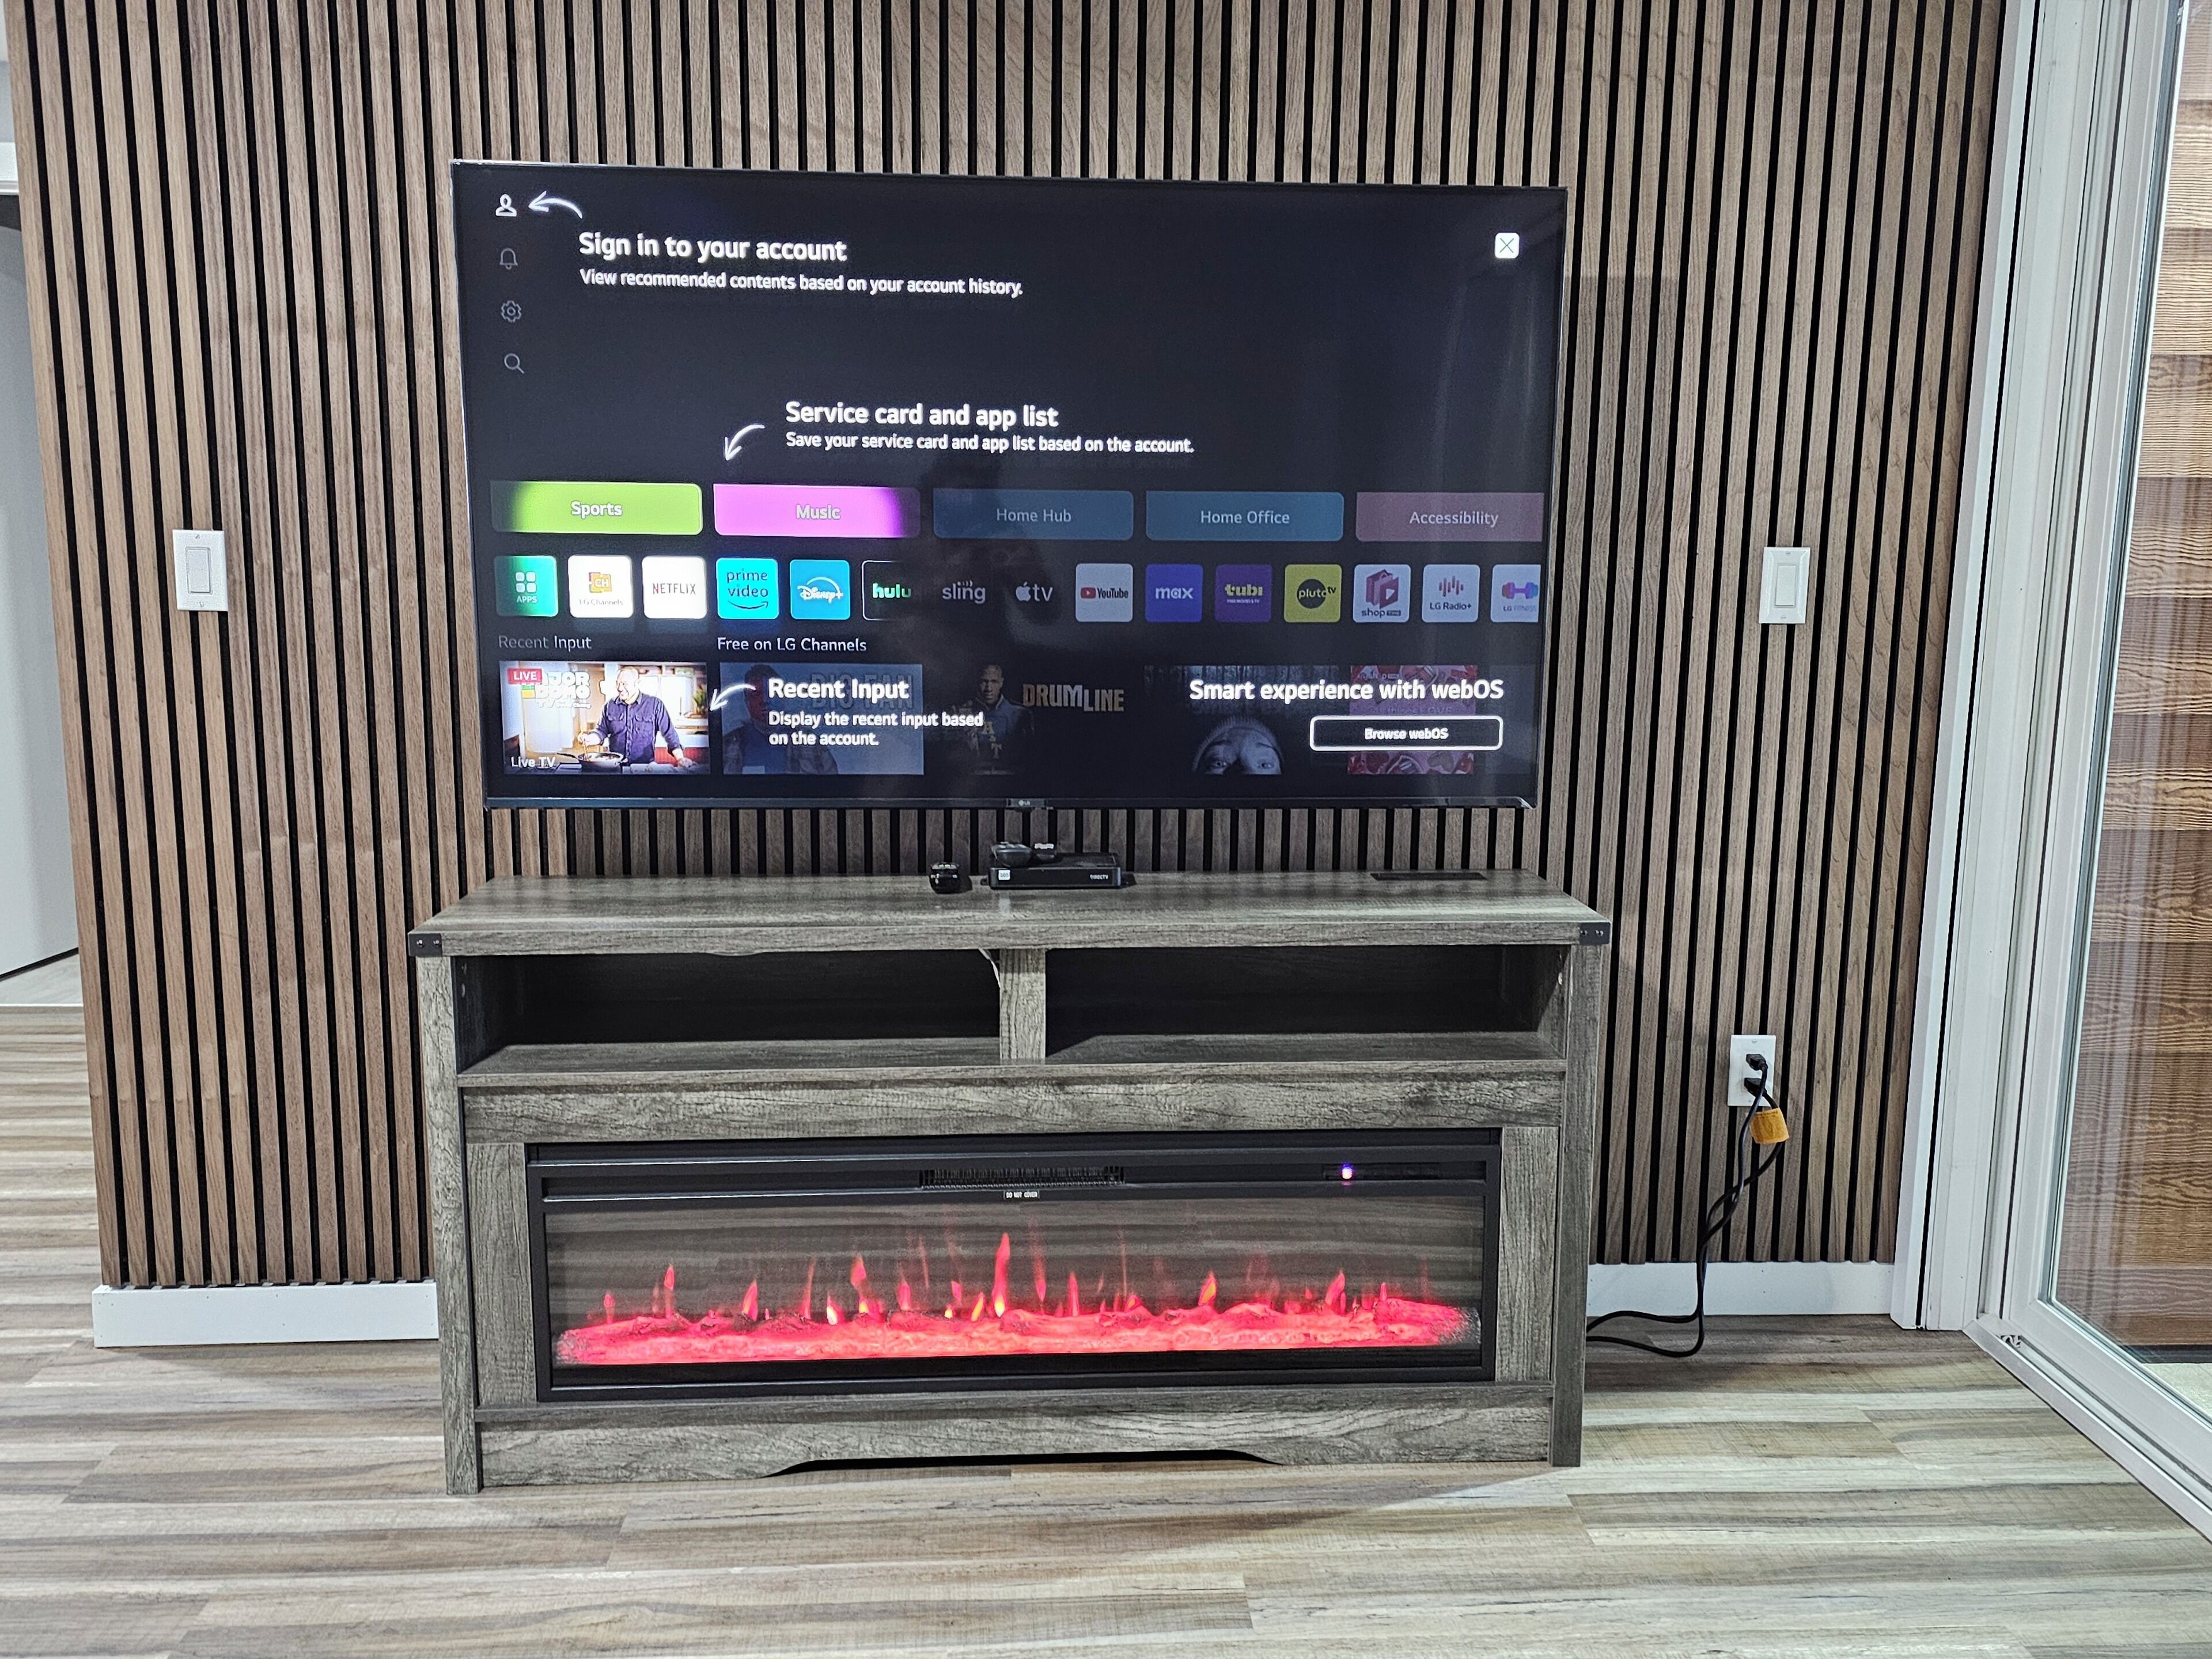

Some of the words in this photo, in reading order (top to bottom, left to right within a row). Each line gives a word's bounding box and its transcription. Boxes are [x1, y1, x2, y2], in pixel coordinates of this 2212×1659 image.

[578, 232, 631, 260] Sign
[637, 233, 659, 256] in
[664, 236, 691, 257] to
[696, 240, 750, 263] your
[756, 241, 847, 261] account
[579, 268, 616, 285] View
[620, 271, 726, 288] recommended
[730, 274, 797, 289] contents
[800, 274, 844, 290] based
[847, 278, 867, 290] on
[870, 279, 904, 295] your
[907, 279, 965, 293] account
[969, 278, 1023, 298] history.
[786, 401, 869, 423] Service
[875, 403, 922, 425] card
[929, 403, 970, 426] and
[976, 408, 1017, 431] app
[1023, 404, 1059, 427] list
[786, 431, 821, 447] Save
[824, 435, 858, 450] your
[862, 433, 913, 449] service
[916, 434, 948, 449] card
[952, 434, 979, 450] and
[982, 437, 1009, 453] app
[1013, 435, 1036, 451] list
[1039, 435, 1082, 452] based
[1085, 439, 1103, 452] on
[1107, 436, 1131, 452] the
[1134, 438, 1195, 453] account.
[571, 501, 623, 518] Sports
[796, 504, 841, 520] Music
[997, 509, 1037, 522] Home
[1043, 509, 1072, 522] Hub
[1200, 510, 1242, 524] Home
[1247, 510, 1290, 524] Office
[1410, 511, 1498, 528] Accessibility
[727, 568, 768, 584] prime
[652, 583, 696, 595] NETFLIX
[728, 584, 768, 597] video
[872, 582, 912, 599] hulu
[942, 580, 986, 604] sling
[1033, 584, 1053, 601] tv
[1097, 588, 1128, 599] YouTube
[1155, 586, 1193, 600] max
[1225, 584, 1263, 597] tubi
[516, 595, 537, 604] APPS
[1443, 602, 1471, 610] Radio+
[1361, 608, 1385, 619] shop
[499, 635, 548, 649] Recent
[554, 636, 592, 652] Input
[717, 637, 749, 650] Free
[754, 640, 772, 650] on
[777, 638, 795, 651] LG
[801, 638, 866, 652] Channels
[513, 671, 537, 681] LIVE
[768, 679, 845, 699] Recent
[852, 679, 910, 704] Input
[1022, 684, 1124, 711] DRUMLINE
[1190, 680, 1255, 700] Smart
[1260, 680, 1373, 704] experience
[1380, 677, 1425, 699] with
[1431, 679, 1504, 700] webOS
[769, 711, 821, 729] Display
[824, 711, 849, 726] the
[853, 714, 898, 727] recent
[902, 712, 939, 729] input
[942, 711, 983, 727] based
[769, 733, 788, 745] on
[791, 730, 816, 745] the
[820, 732, 879, 746] account.
[1365, 728, 1407, 741] Browse
[1409, 727, 1449, 740] webOS
[511, 756, 535, 768] Live
[539, 757, 556, 768] TV
